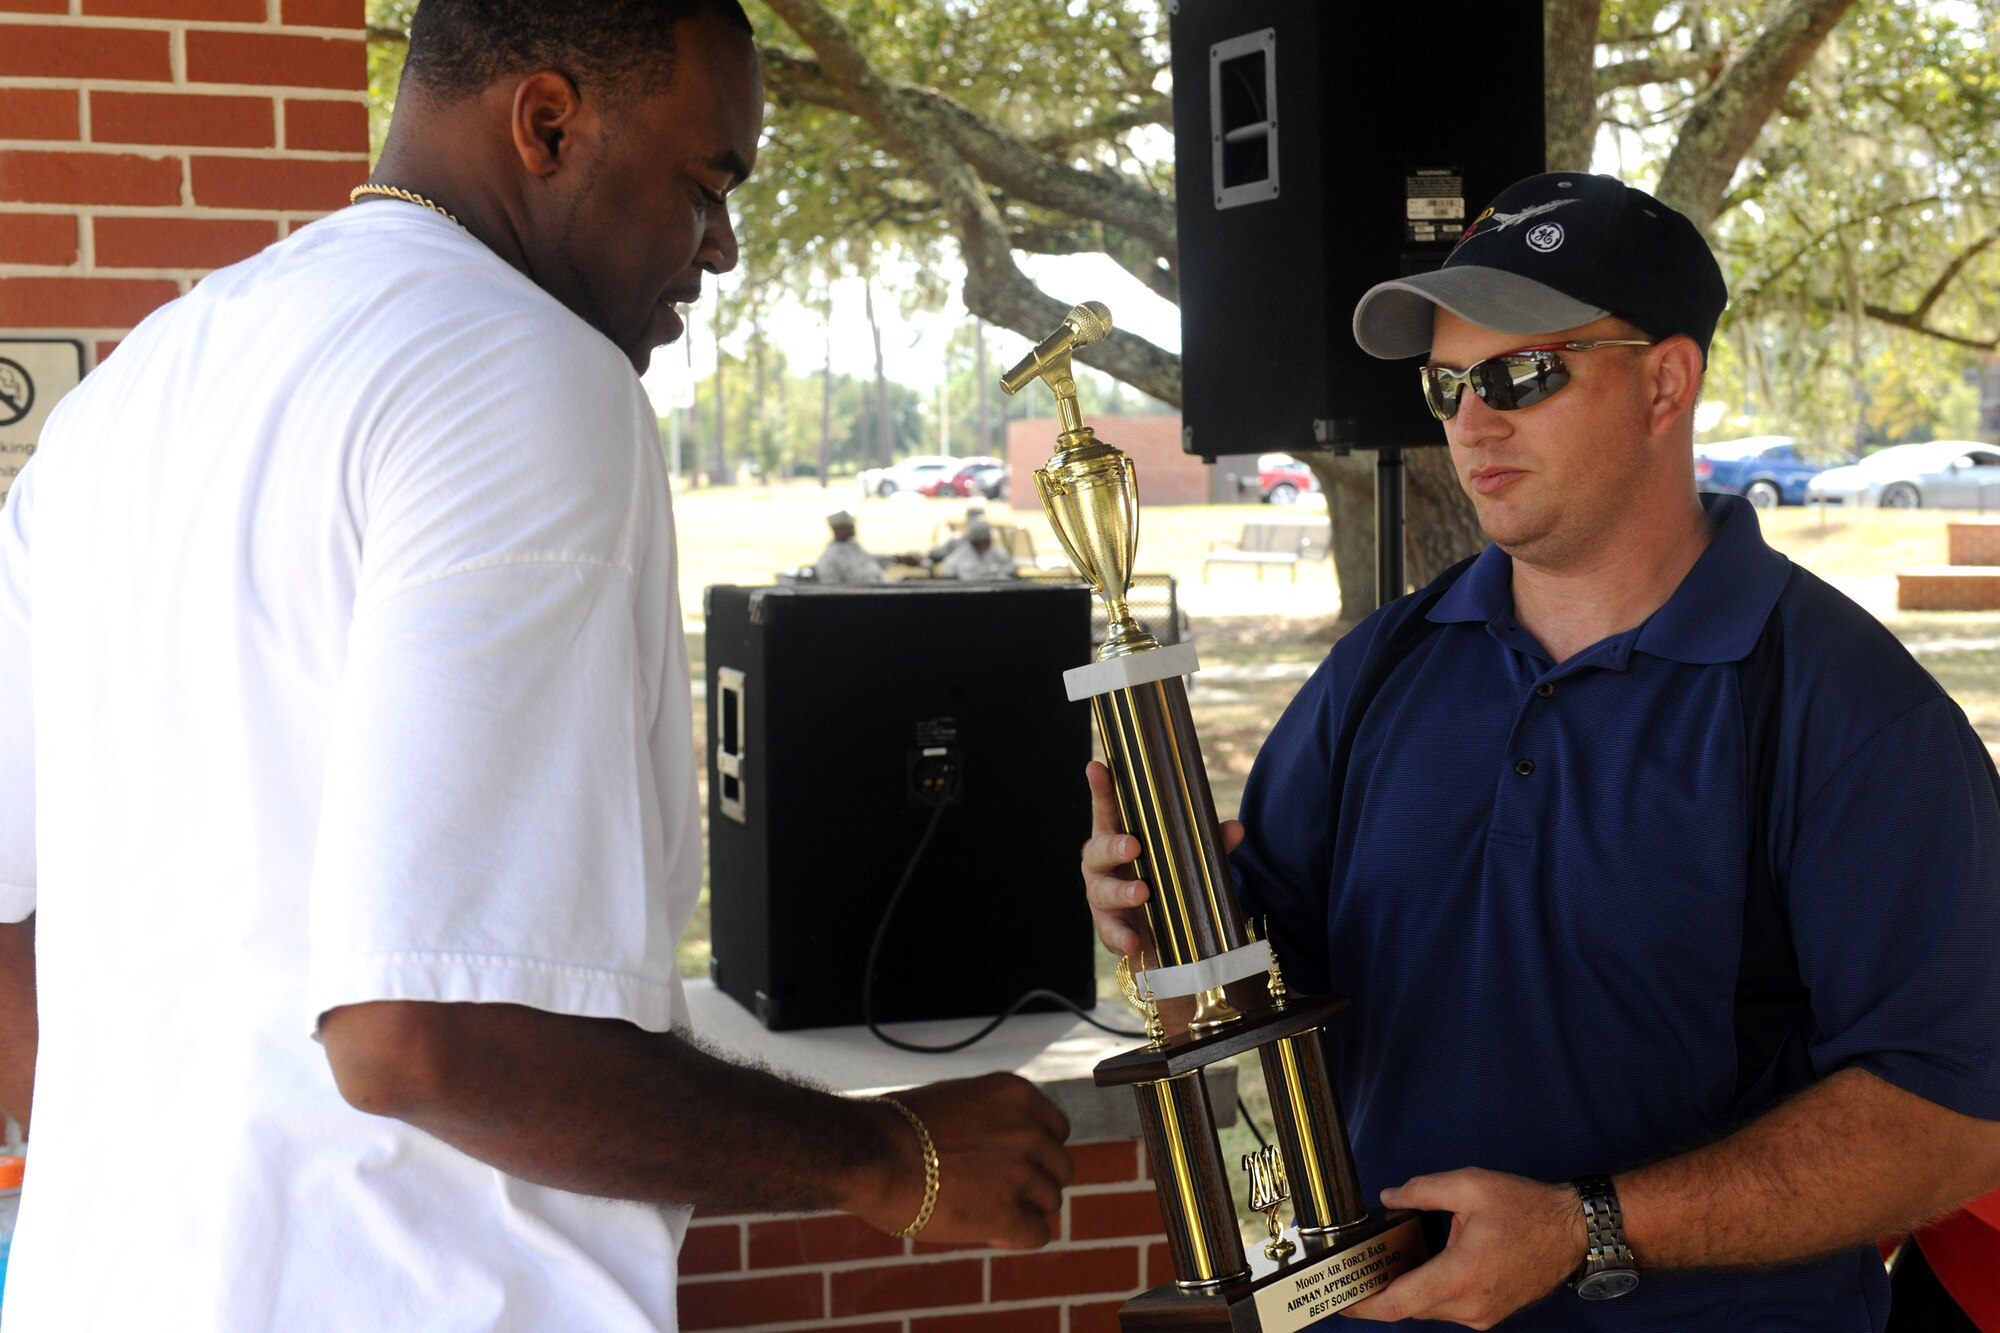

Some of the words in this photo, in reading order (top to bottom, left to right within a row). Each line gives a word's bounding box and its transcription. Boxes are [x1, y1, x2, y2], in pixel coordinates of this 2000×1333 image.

[1287, 1287, 1322, 1312] AIRMAN
[1323, 1259, 1384, 1295] APPRECIATION
[1385, 1250, 1402, 1267] DAY
[1295, 1271, 1325, 1291] MOODY
[1327, 1263, 1341, 1278] AIR
[1342, 1252, 1366, 1272] FORCE
[1368, 1242, 1388, 1258] BASE
[1309, 1300, 1330, 1317] BEST
[1331, 1286, 1358, 1306] SOUND
[1359, 1272, 1389, 1293] SYSTEM
